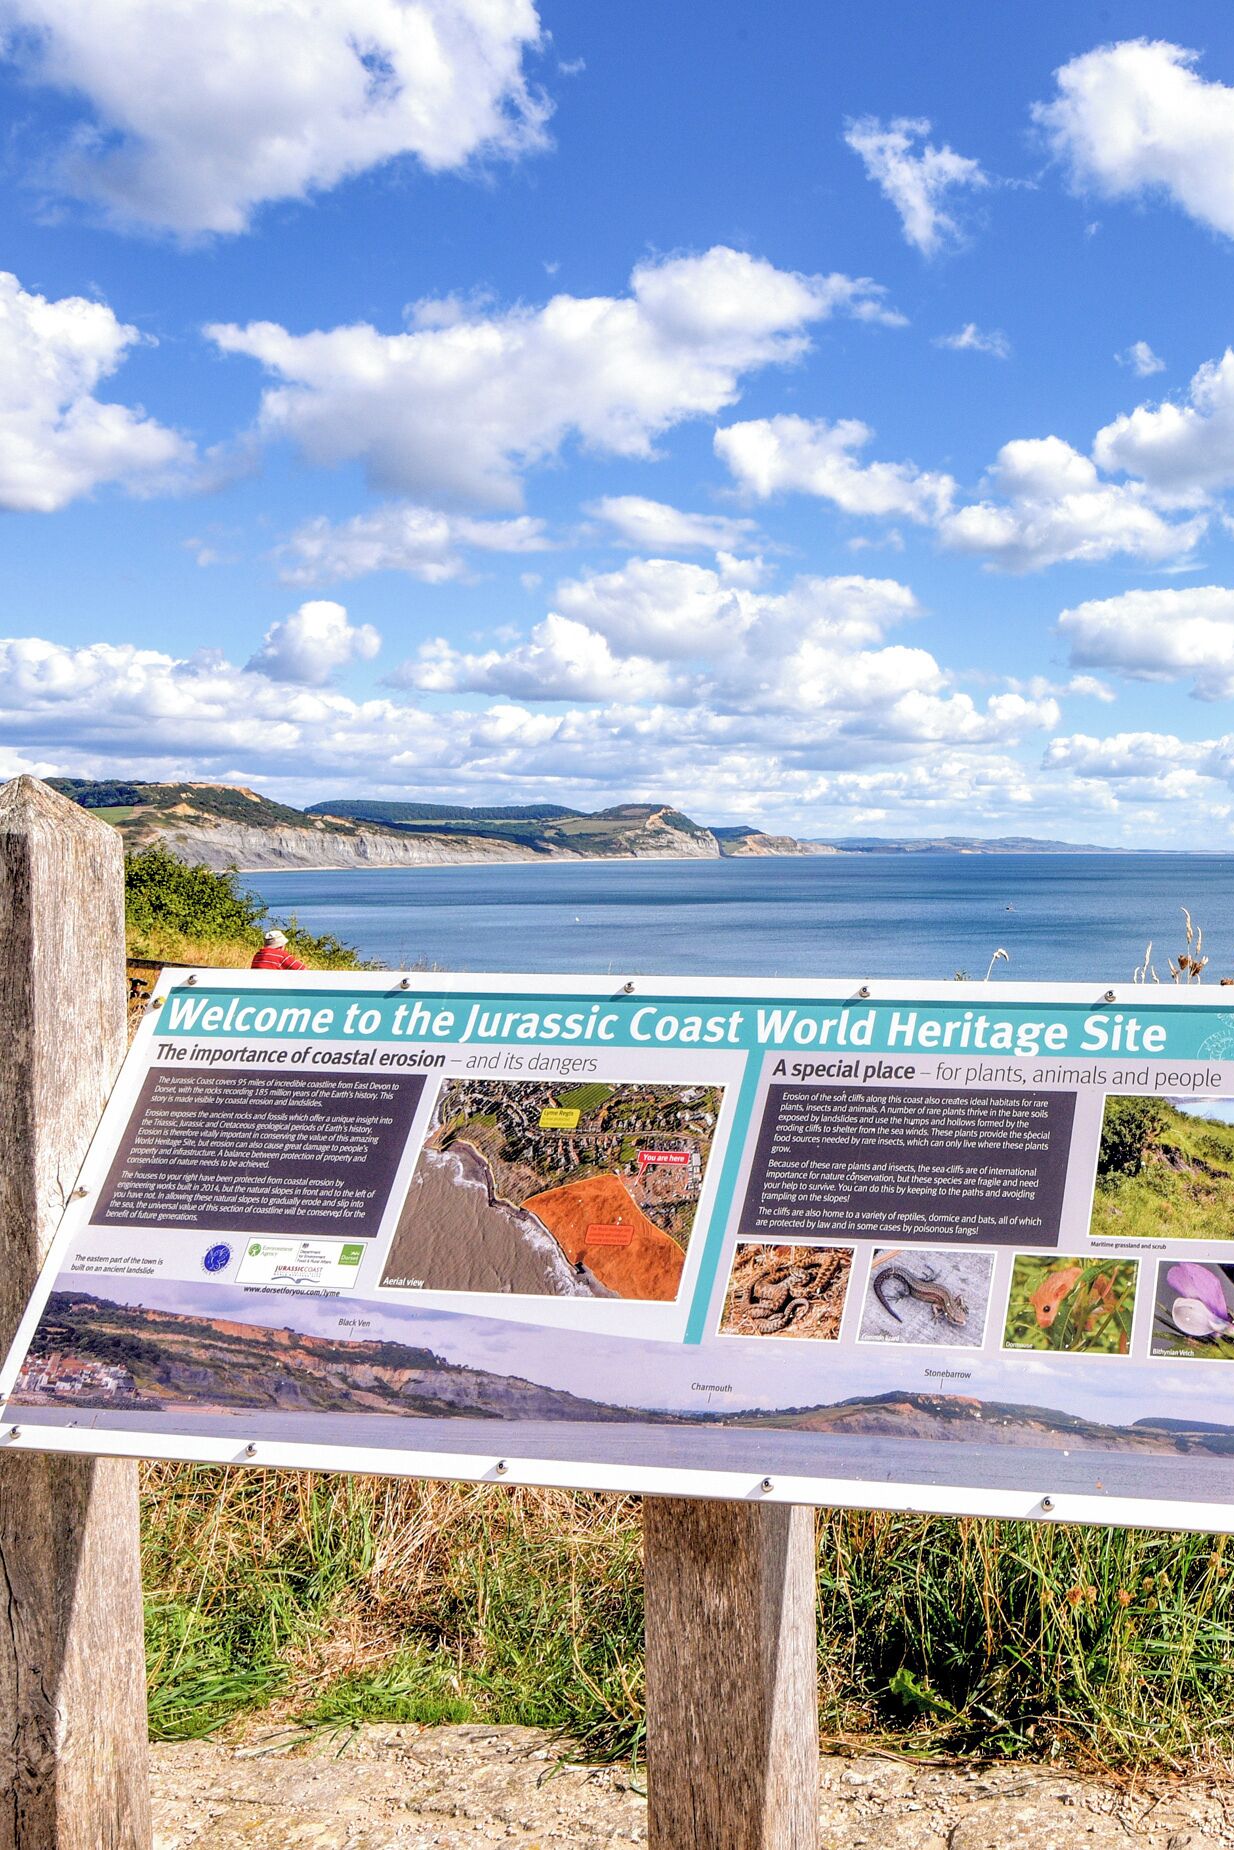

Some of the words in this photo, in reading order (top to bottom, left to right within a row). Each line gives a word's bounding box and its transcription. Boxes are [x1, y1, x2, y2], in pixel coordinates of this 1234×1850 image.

[168, 998, 334, 1034] Welcome
[343, 1003, 382, 1035] to
[391, 1002, 455, 1037] the
[459, 1004, 619, 1042] Jurassic
[629, 1006, 744, 1043] Coast
[757, 1009, 877, 1046] World
[887, 1012, 1068, 1055] Heritage
[1080, 1013, 1167, 1052] Site
[156, 1043, 188, 1061] The
[189, 1043, 288, 1066] importance
[290, 1046, 313, 1064] of
[311, 1048, 378, 1066] coastal
[379, 1049, 446, 1068] erosion
[466, 1051, 501, 1069] and
[503, 1052, 524, 1070] its
[528, 1053, 598, 1075] dangers
[772, 1058, 787, 1076] A
[790, 1059, 860, 1082] special
[862, 1060, 916, 1083] place
[936, 1062, 962, 1081] for
[965, 1063, 1026, 1085] plants,
[1032, 1065, 1107, 1085] animals
[1112, 1066, 1149, 1086] and
[1154, 1068, 1222, 1091] people
[643, 1153, 657, 1161] You
[669, 1154, 685, 1162] here
[768, 1219, 806, 1228] protected
[806, 1220, 817, 1230] by
[816, 1220, 831, 1229] law
[831, 1221, 847, 1229] and
[847, 1221, 856, 1230] in
[856, 1223, 879, 1231] some
[879, 1224, 901, 1232] cases
[902, 1223, 913, 1234] by
[913, 1224, 954, 1234] poisonous
[955, 1225, 979, 1237] fangs!
[75, 1254, 86, 1262] The
[122, 1256, 131, 1264] of
[157, 1258, 164, 1266] is
[70, 1263, 86, 1271] built
[102, 1265, 126, 1273] ancient
[126, 1266, 155, 1275] landslide
[382, 1276, 406, 1286] Aerial
[406, 1278, 425, 1288] view
[244, 1286, 340, 1297] www.dorsetforyou.com/lyme
[338, 1318, 357, 1327] Black
[358, 1319, 371, 1327] Ven
[924, 1368, 972, 1379] Stonebarrow
[691, 1382, 733, 1392] Charmouth
